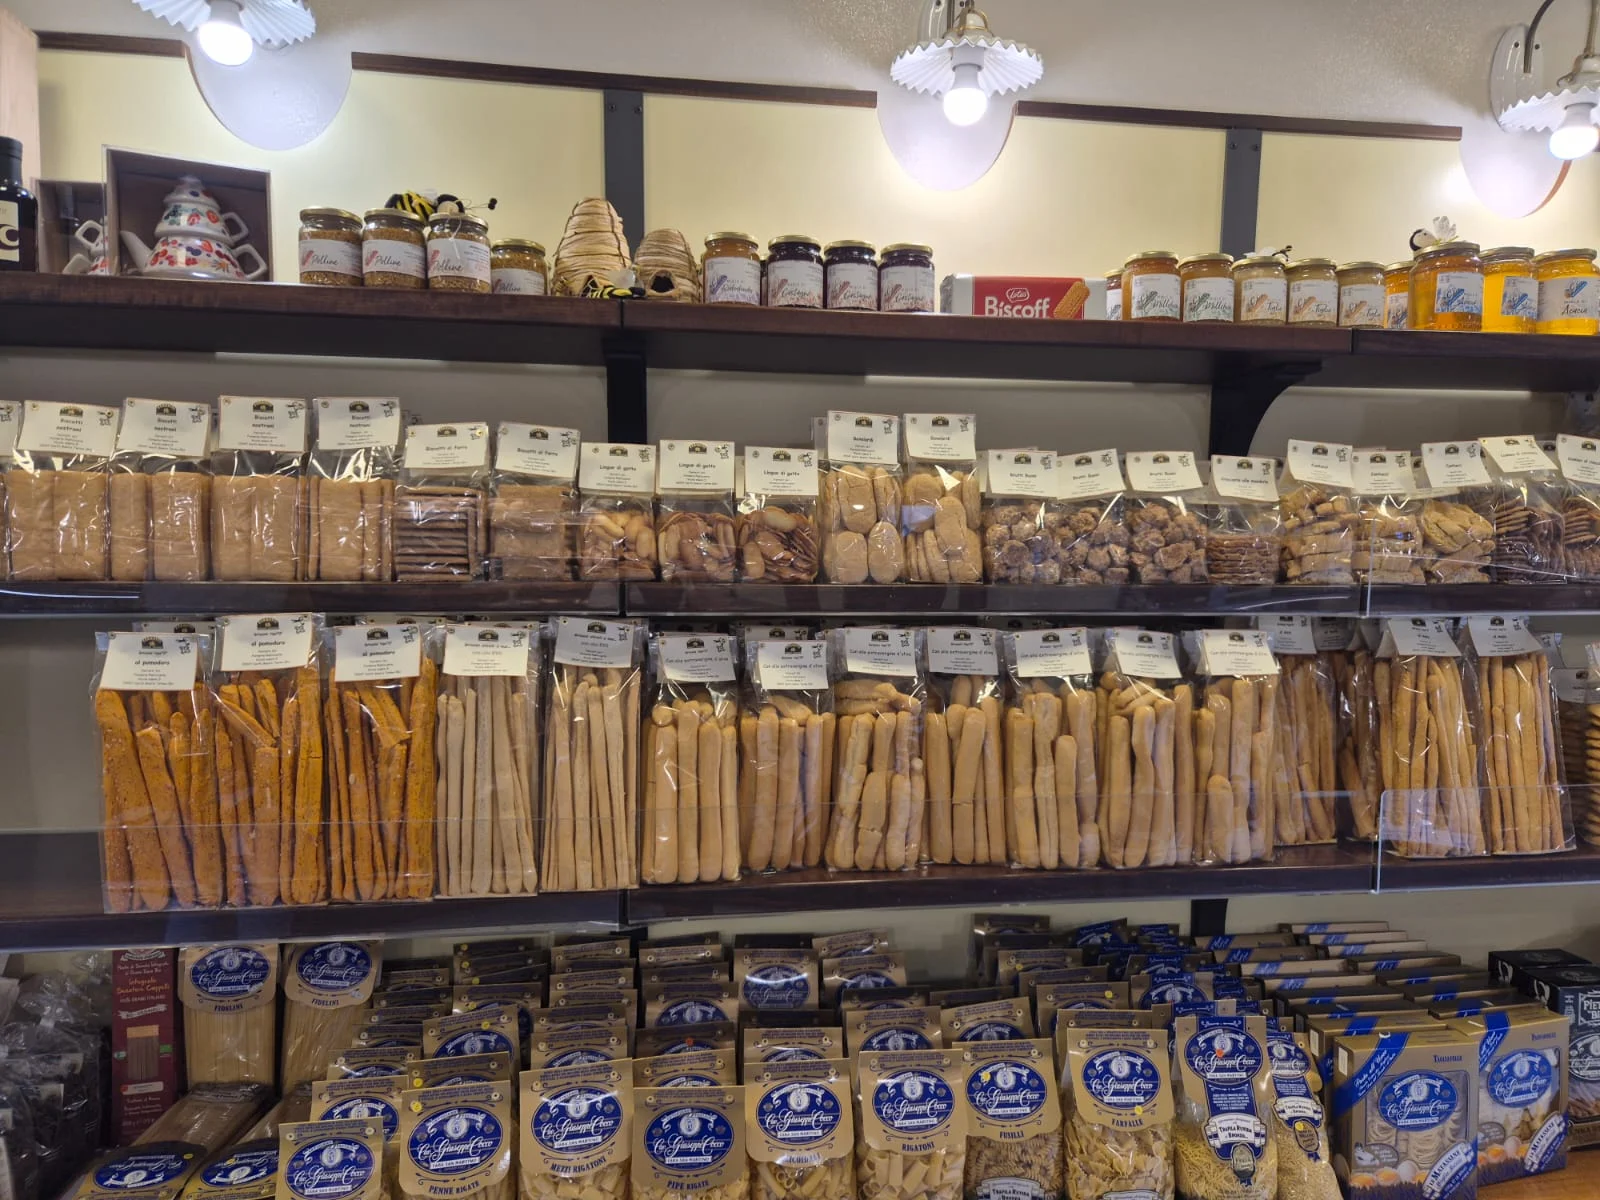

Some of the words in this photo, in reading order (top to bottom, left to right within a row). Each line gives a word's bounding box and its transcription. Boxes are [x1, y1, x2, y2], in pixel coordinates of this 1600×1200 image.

[1007, 289, 1028, 299] Lotus
[984, 297, 1050, 318] Biscoff
[1000, 1131, 1024, 1139] FUSILLI
[902, 1141, 935, 1152] RIGATONI
[573, 1156, 607, 1173] RIGATONI
[429, 1184, 454, 1195] PENNE
[455, 1180, 480, 1193] RIGATE
[667, 1180, 684, 1190] PIPE
